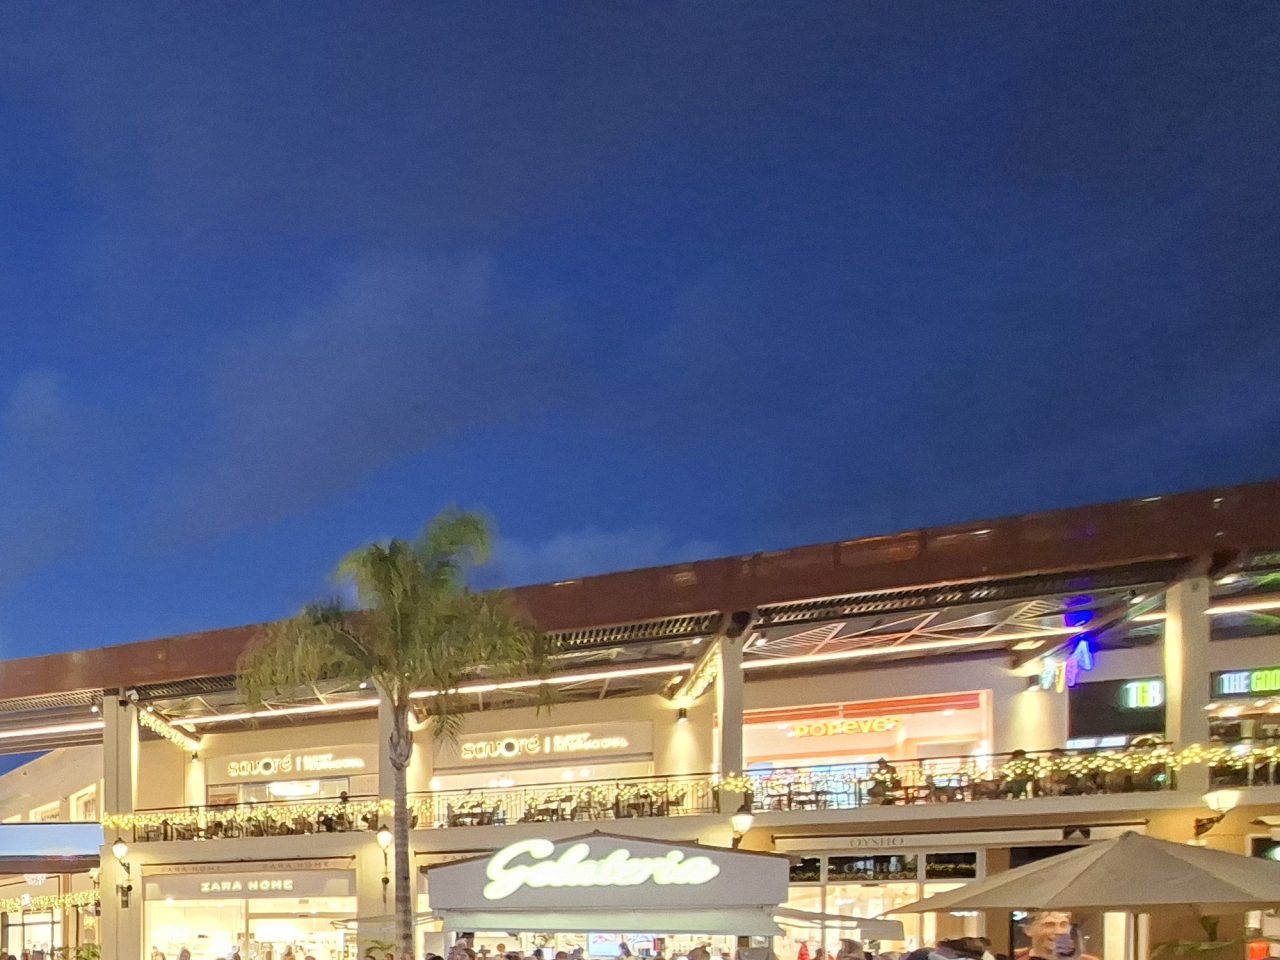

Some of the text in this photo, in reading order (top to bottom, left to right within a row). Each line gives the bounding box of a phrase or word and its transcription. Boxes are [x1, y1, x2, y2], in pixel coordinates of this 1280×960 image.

[1220, 668, 1280, 694] THE GOO
[1124, 680, 1164, 708] TGB
[849, 837, 905, 848] OYSHO
[200, 879, 294, 893] ZARA HOME
